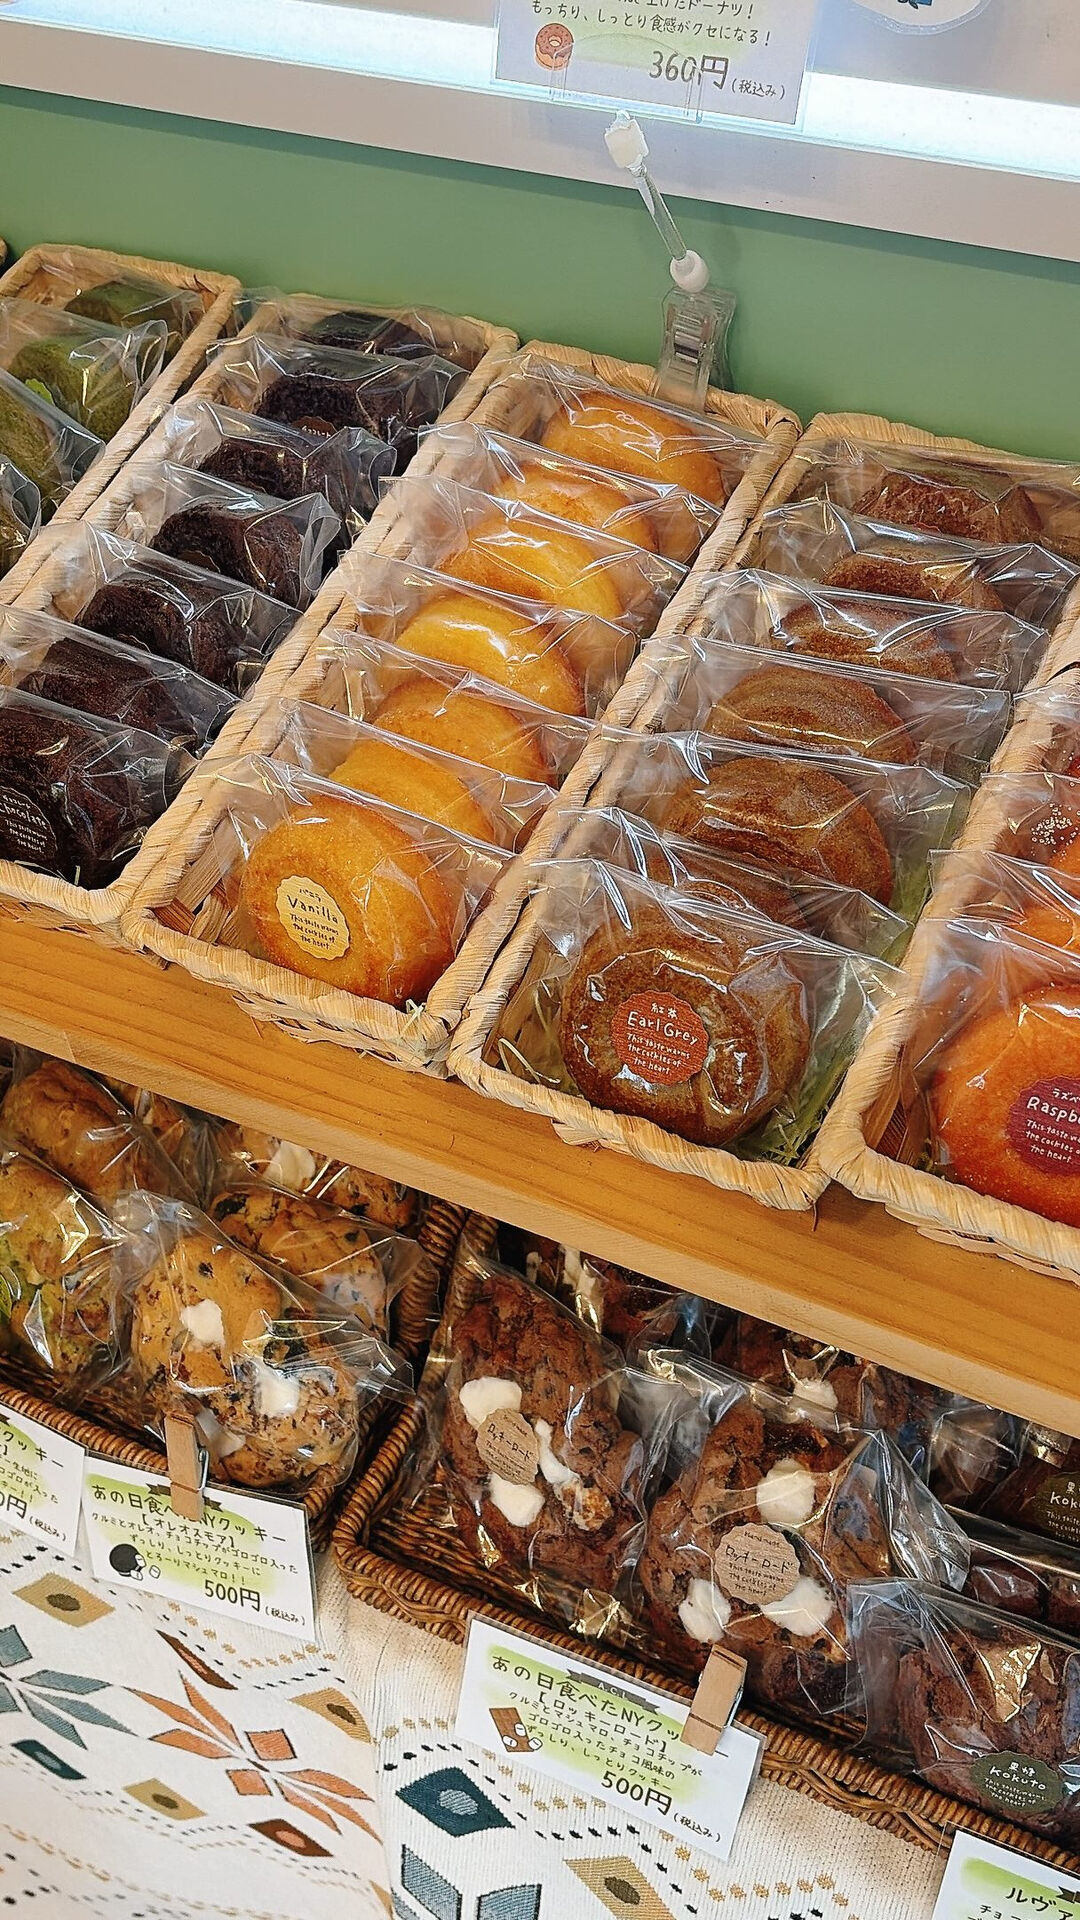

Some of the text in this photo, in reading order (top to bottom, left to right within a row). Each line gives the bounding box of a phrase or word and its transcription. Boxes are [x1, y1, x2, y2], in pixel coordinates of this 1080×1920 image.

[532, 0, 771, 46] もっちり、しっとり食感がクセになる！
[649, 50, 786, 100] 360円 (税込み)
[286, 895, 339, 924] Vanilla
[650, 1002, 678, 1020] 紅茶
[627, 1011, 699, 1046] Earl Grey
[627, 1032, 691, 1059] This taste warms
[628, 1043, 681, 1068] the cockles of
[634, 1056, 671, 1075] the heart
[1026, 1095, 1080, 1125] Raspb
[1026, 1118, 1045, 1131] This
[1046, 1125, 1069, 1140] taste
[1026, 1130, 1040, 1141] the
[1040, 1137, 1074, 1153] cockles
[1030, 1144, 1072, 1163] the heart
[0, 1427, 64, 1468] クッキー
[0, 1454, 38, 1481] ー生地に
[92, 1484, 286, 1542] あの日食べNYクッキー
[1050, 1491, 1080, 1510] Kok
[725, 1544, 794, 1574] ロッキーロード
[204, 1579, 305, 1626] 500円 (税込み)
[492, 1655, 729, 1758] あの日食べたNYクッー
[538, 1690, 667, 1753] 【ロッキーロード】
[528, 1713, 675, 1780] ゴロゴロ入ったチョコ風味の
[601, 1769, 721, 1842] 500円 (税込み)
[979, 1904, 1022, 1920] チョ
